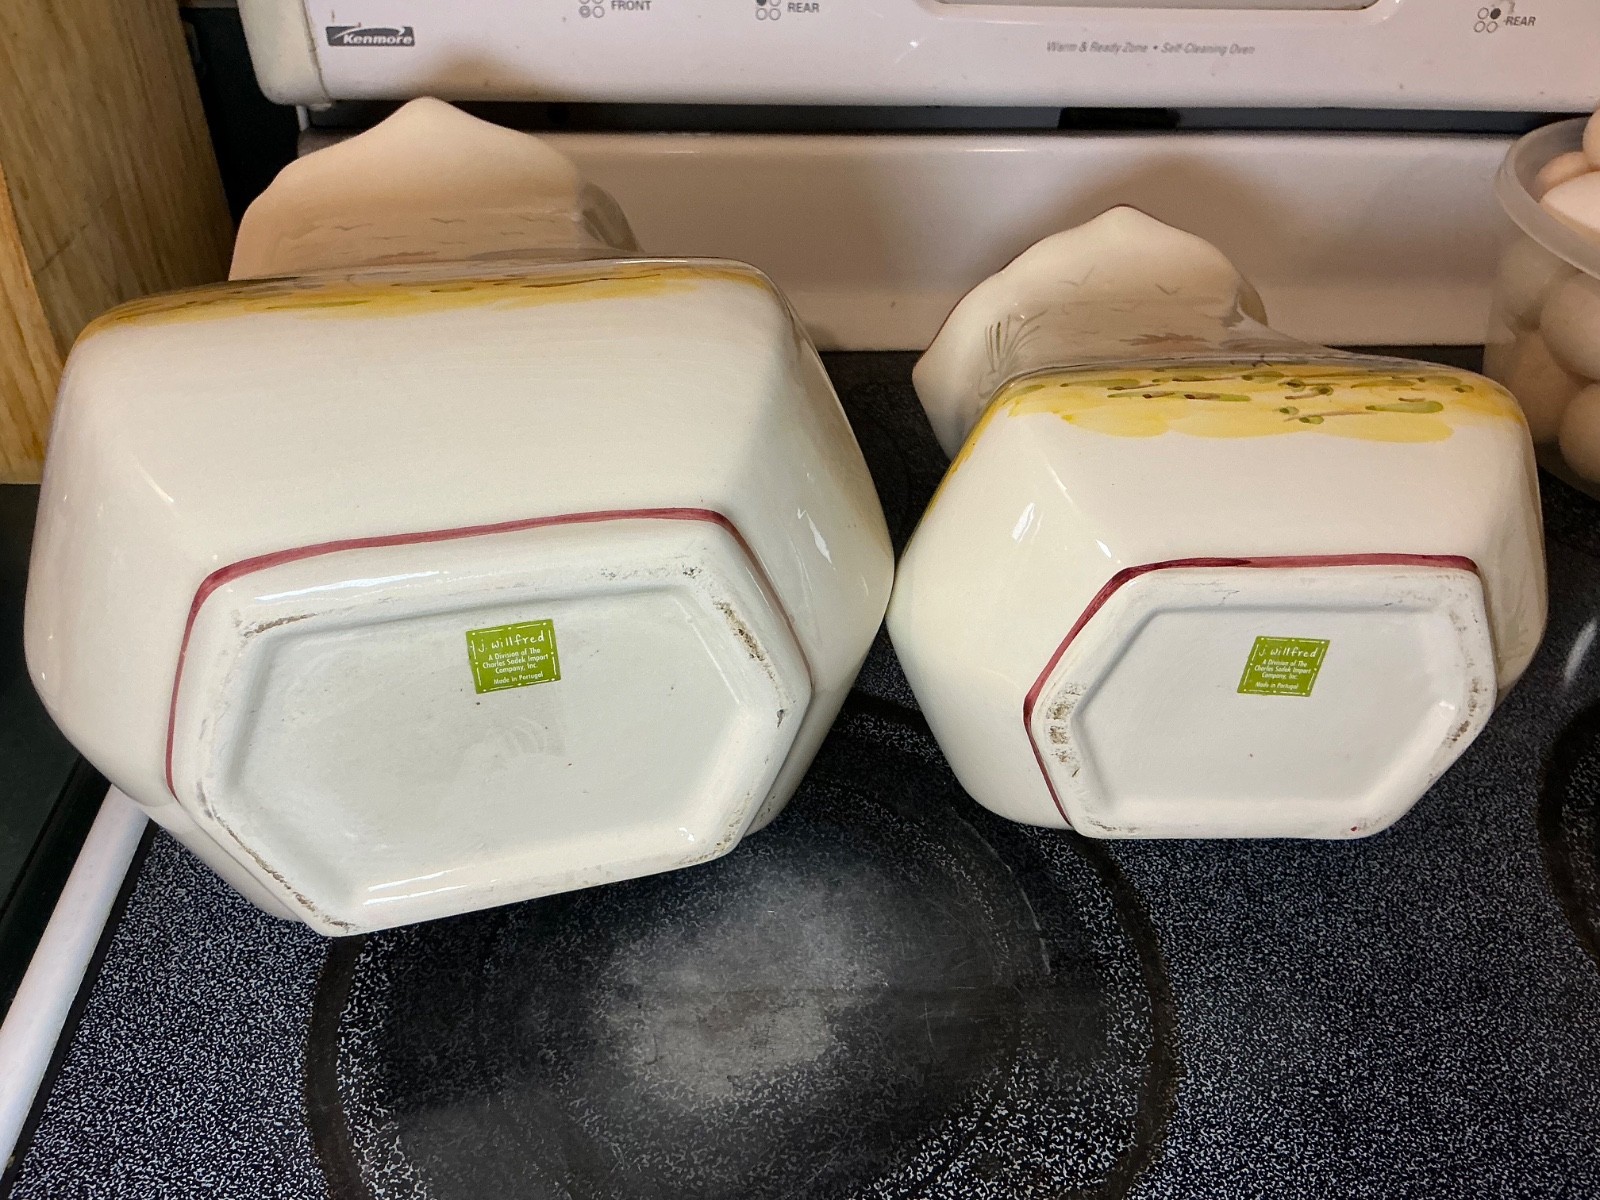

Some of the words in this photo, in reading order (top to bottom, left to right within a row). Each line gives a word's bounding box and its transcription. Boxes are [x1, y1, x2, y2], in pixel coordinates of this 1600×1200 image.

[611, 0, 651, 10] FRONT
[787, 2, 819, 13] REAR
[1505, 16, 1536, 26] REAR
[343, 33, 412, 45] Kenmore
[1046, 41, 1078, 52] Warm
[1079, 41, 1087, 52] &
[1090, 41, 1121, 55] Ready
[1122, 41, 1148, 53] Zone
[1229, 43, 1256, 54] Oven
[494, 651, 520, 660] Division
[520, 648, 527, 656] of
[482, 659, 506, 669] Charles
[506, 656, 526, 665] Sadek
[528, 654, 549, 662] Import
[1267, 658, 1289, 666] Division
[495, 665, 526, 674] Company,
[493, 676, 510, 685] Made
[518, 671, 544, 680] Portugal
[1276, 682, 1300, 691] Portugal
